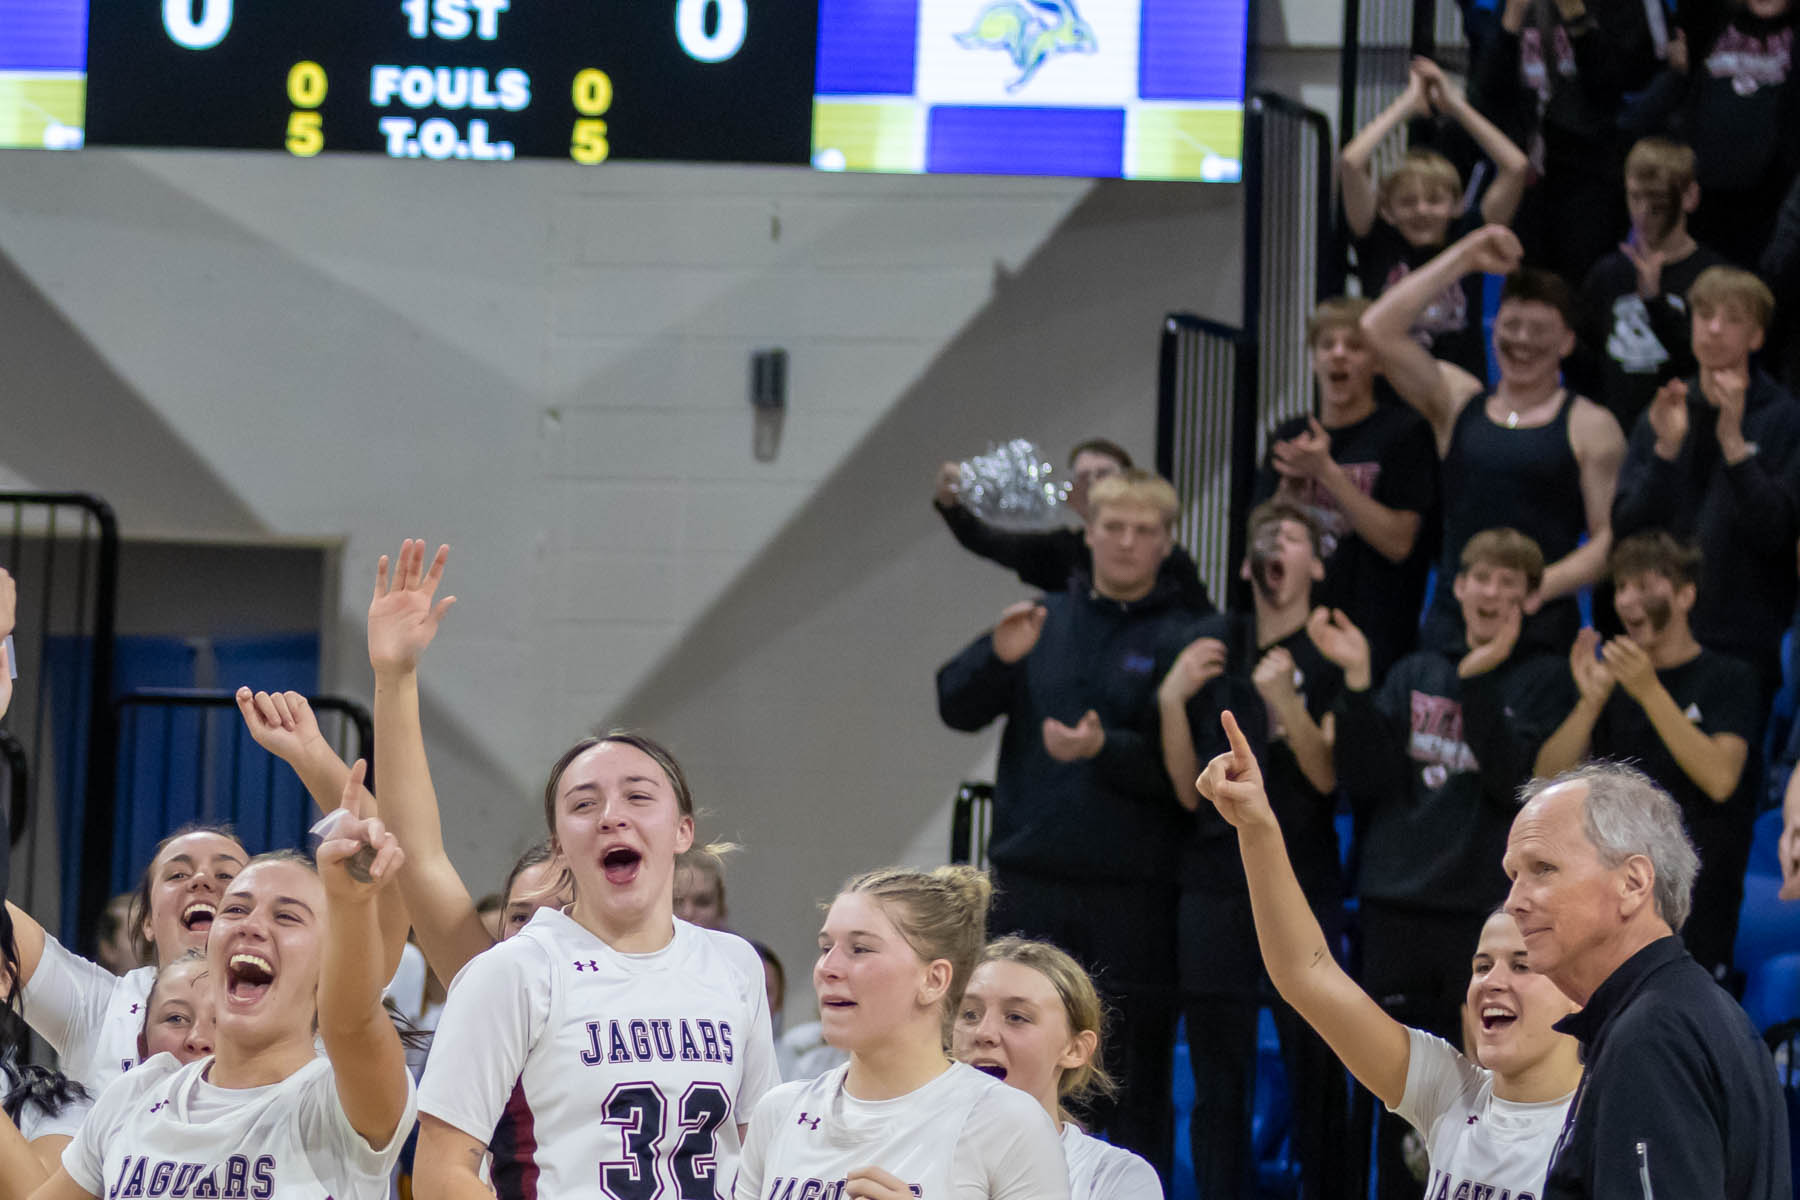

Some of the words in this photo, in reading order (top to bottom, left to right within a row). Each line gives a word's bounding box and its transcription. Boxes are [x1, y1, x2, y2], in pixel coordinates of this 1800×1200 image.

[161, 0, 234, 50] 0
[403, 0, 508, 40] 1ST
[674, 0, 749, 63] 0
[286, 60, 328, 109] 0
[369, 64, 531, 111] FOULS
[571, 68, 612, 116] 0
[285, 110, 325, 157] 5
[380, 116, 515, 160] T.O.L.
[570, 117, 609, 165] 5
[580, 1018, 733, 1066] JAGUARS
[109, 1153, 276, 1200] JAGUARS
